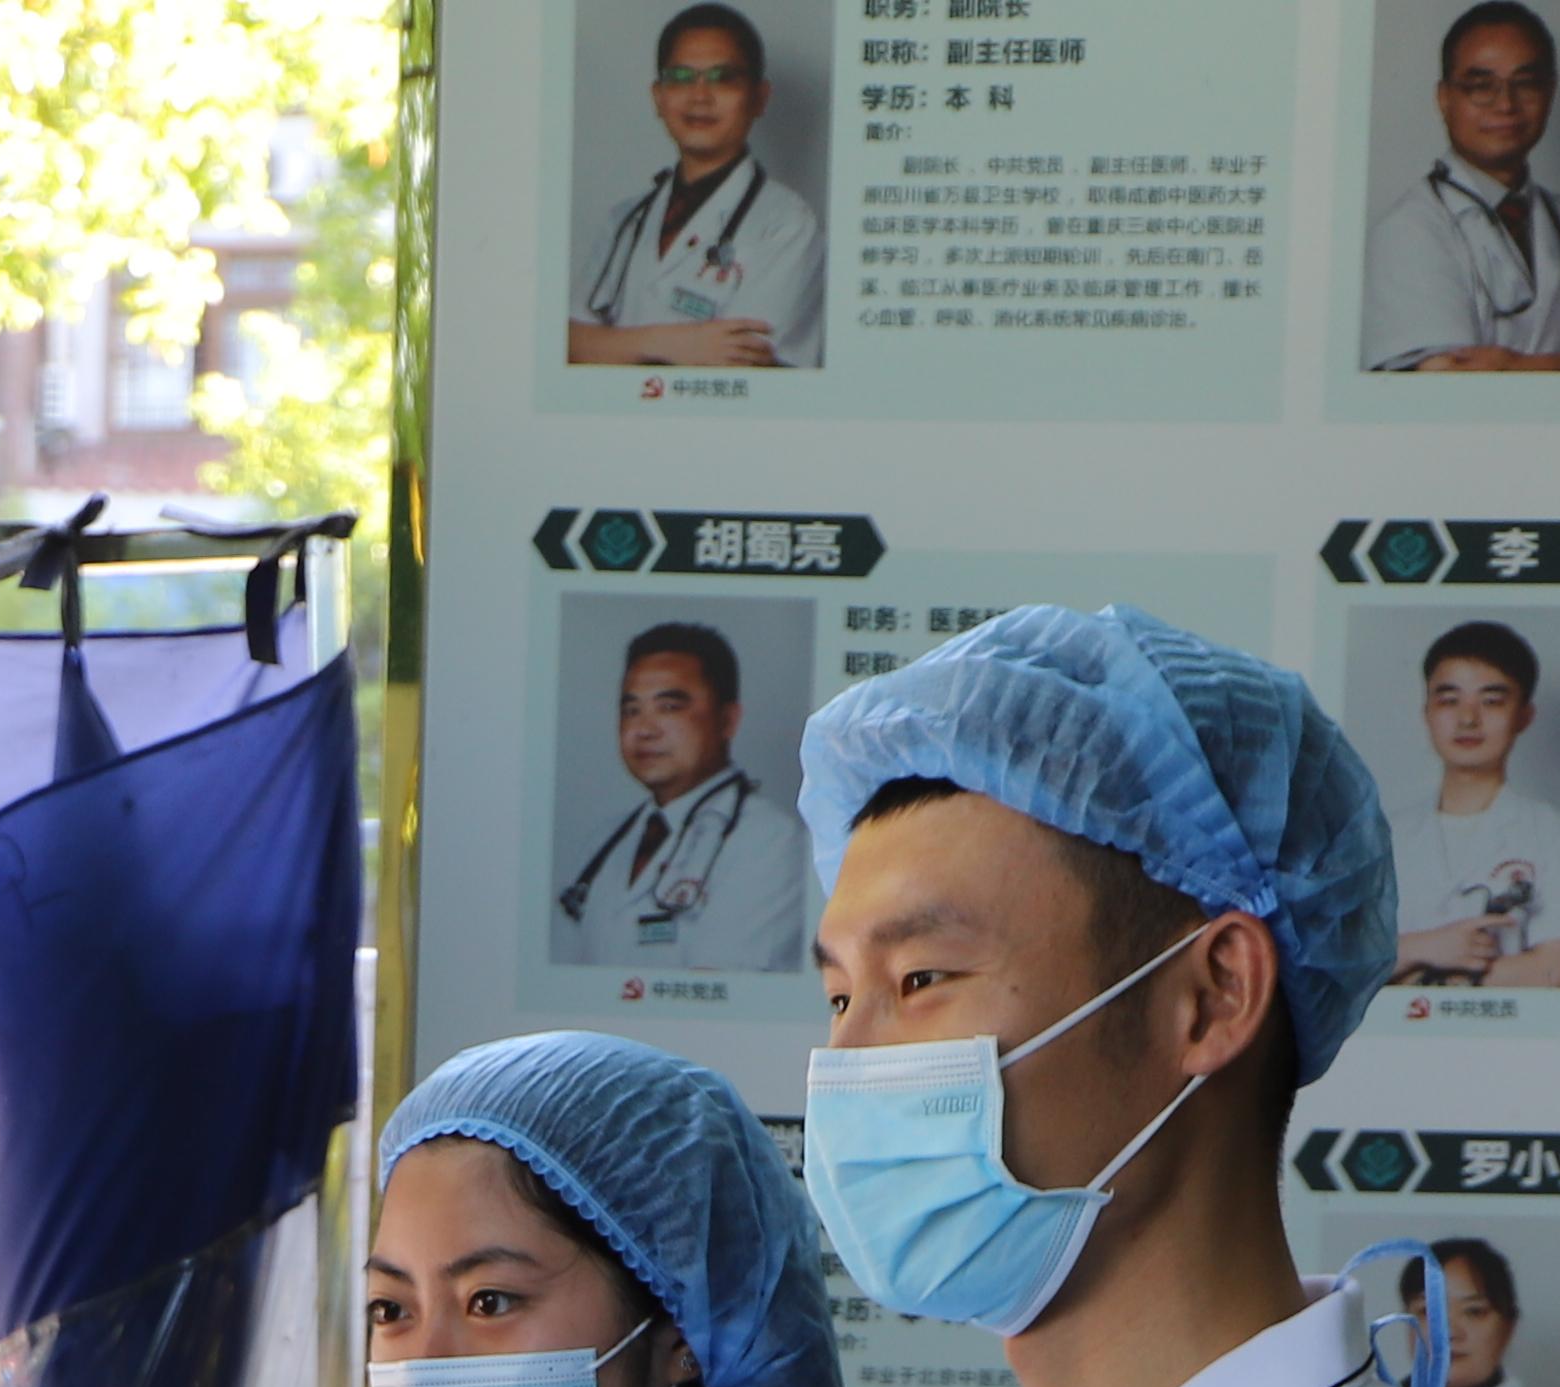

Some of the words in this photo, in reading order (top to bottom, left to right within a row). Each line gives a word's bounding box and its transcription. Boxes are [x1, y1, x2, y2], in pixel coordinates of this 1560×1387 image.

[862, 39, 1084, 65] 职称：副主任医师
[695, 519, 843, 572] 胡蜀亮
[922, 1095, 978, 1116] YUBEI
